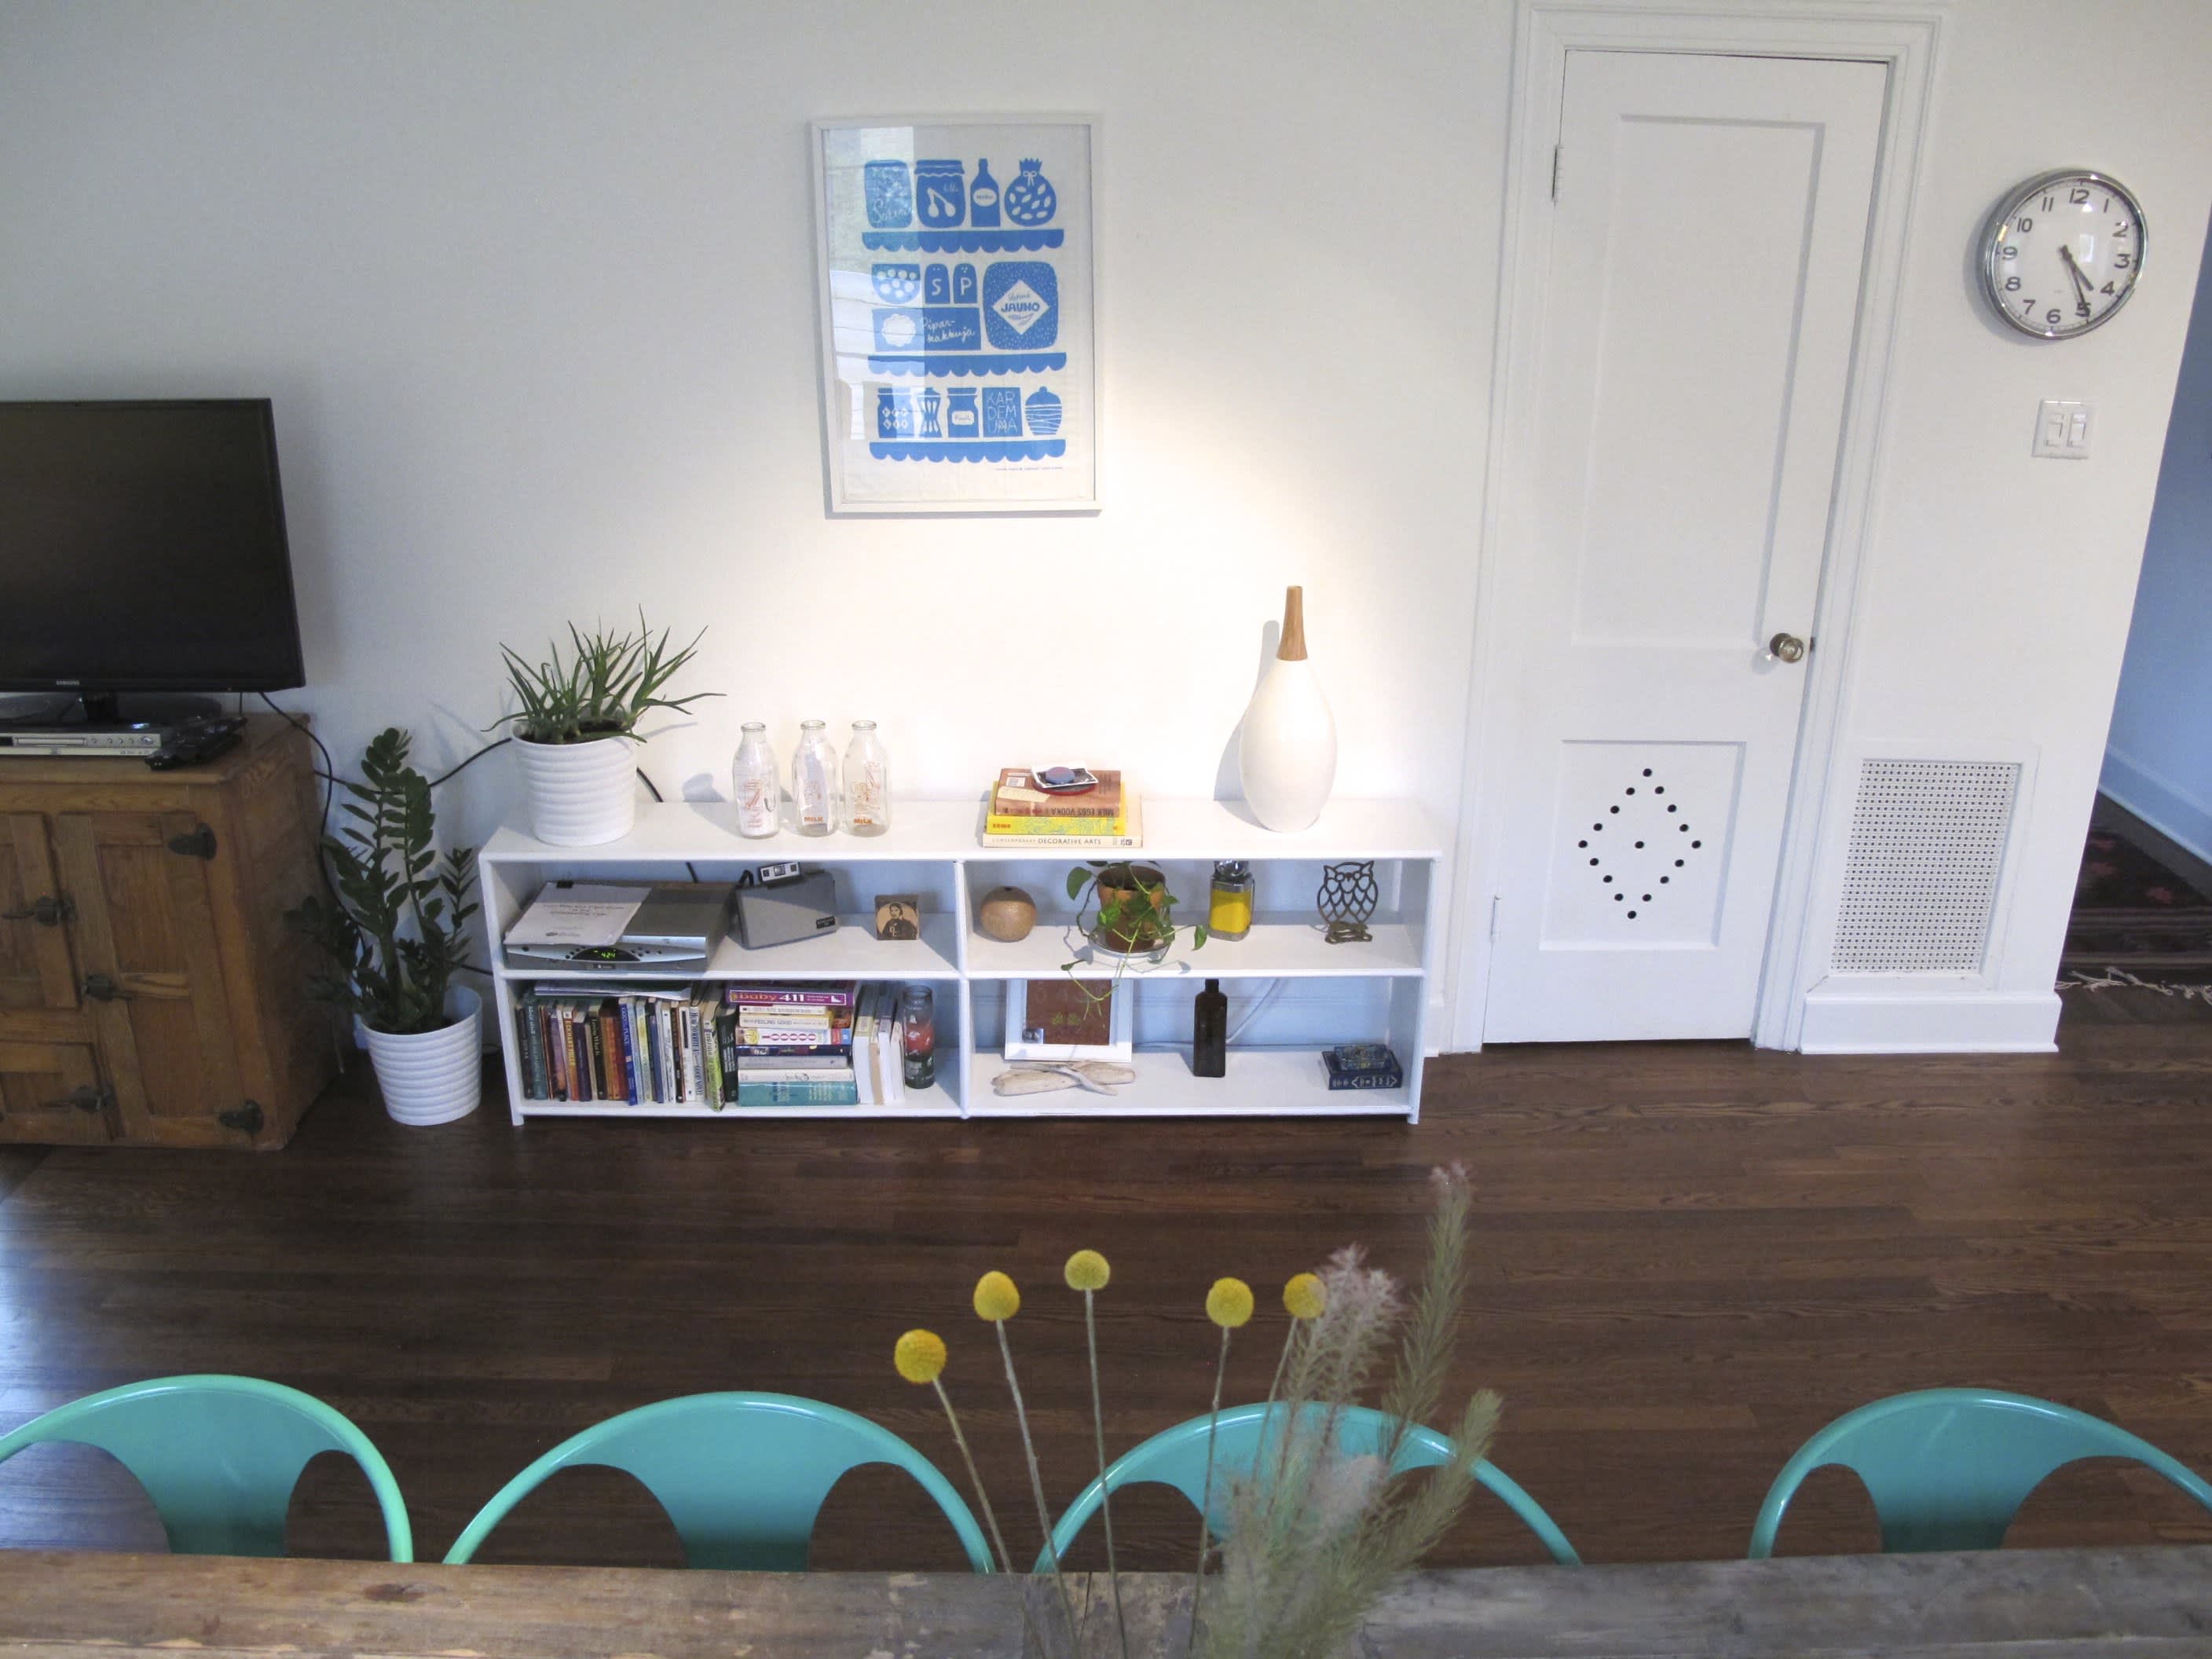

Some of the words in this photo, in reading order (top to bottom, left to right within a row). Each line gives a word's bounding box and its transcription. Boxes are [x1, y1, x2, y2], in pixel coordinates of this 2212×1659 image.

[2069, 189, 2090, 204] 12
[2042, 197, 2053, 212] 11
[2103, 198, 2109, 213] 1
[2016, 218, 2033, 233] 10
[2112, 222, 2129, 238] 2
[2002, 246, 2018, 260] 9
[2115, 254, 2131, 269] 3
[932, 278, 942, 296] S
[960, 277, 972, 296] P
[2005, 276, 2021, 291] 8
[2100, 280, 2115, 295] 4
[1001, 302, 1040, 313] JAUHO
[2023, 299, 2036, 315] 7
[2075, 302, 2091, 317] 5
[2046, 309, 2061, 324] 6
[987, 405, 1017, 421] DEM
